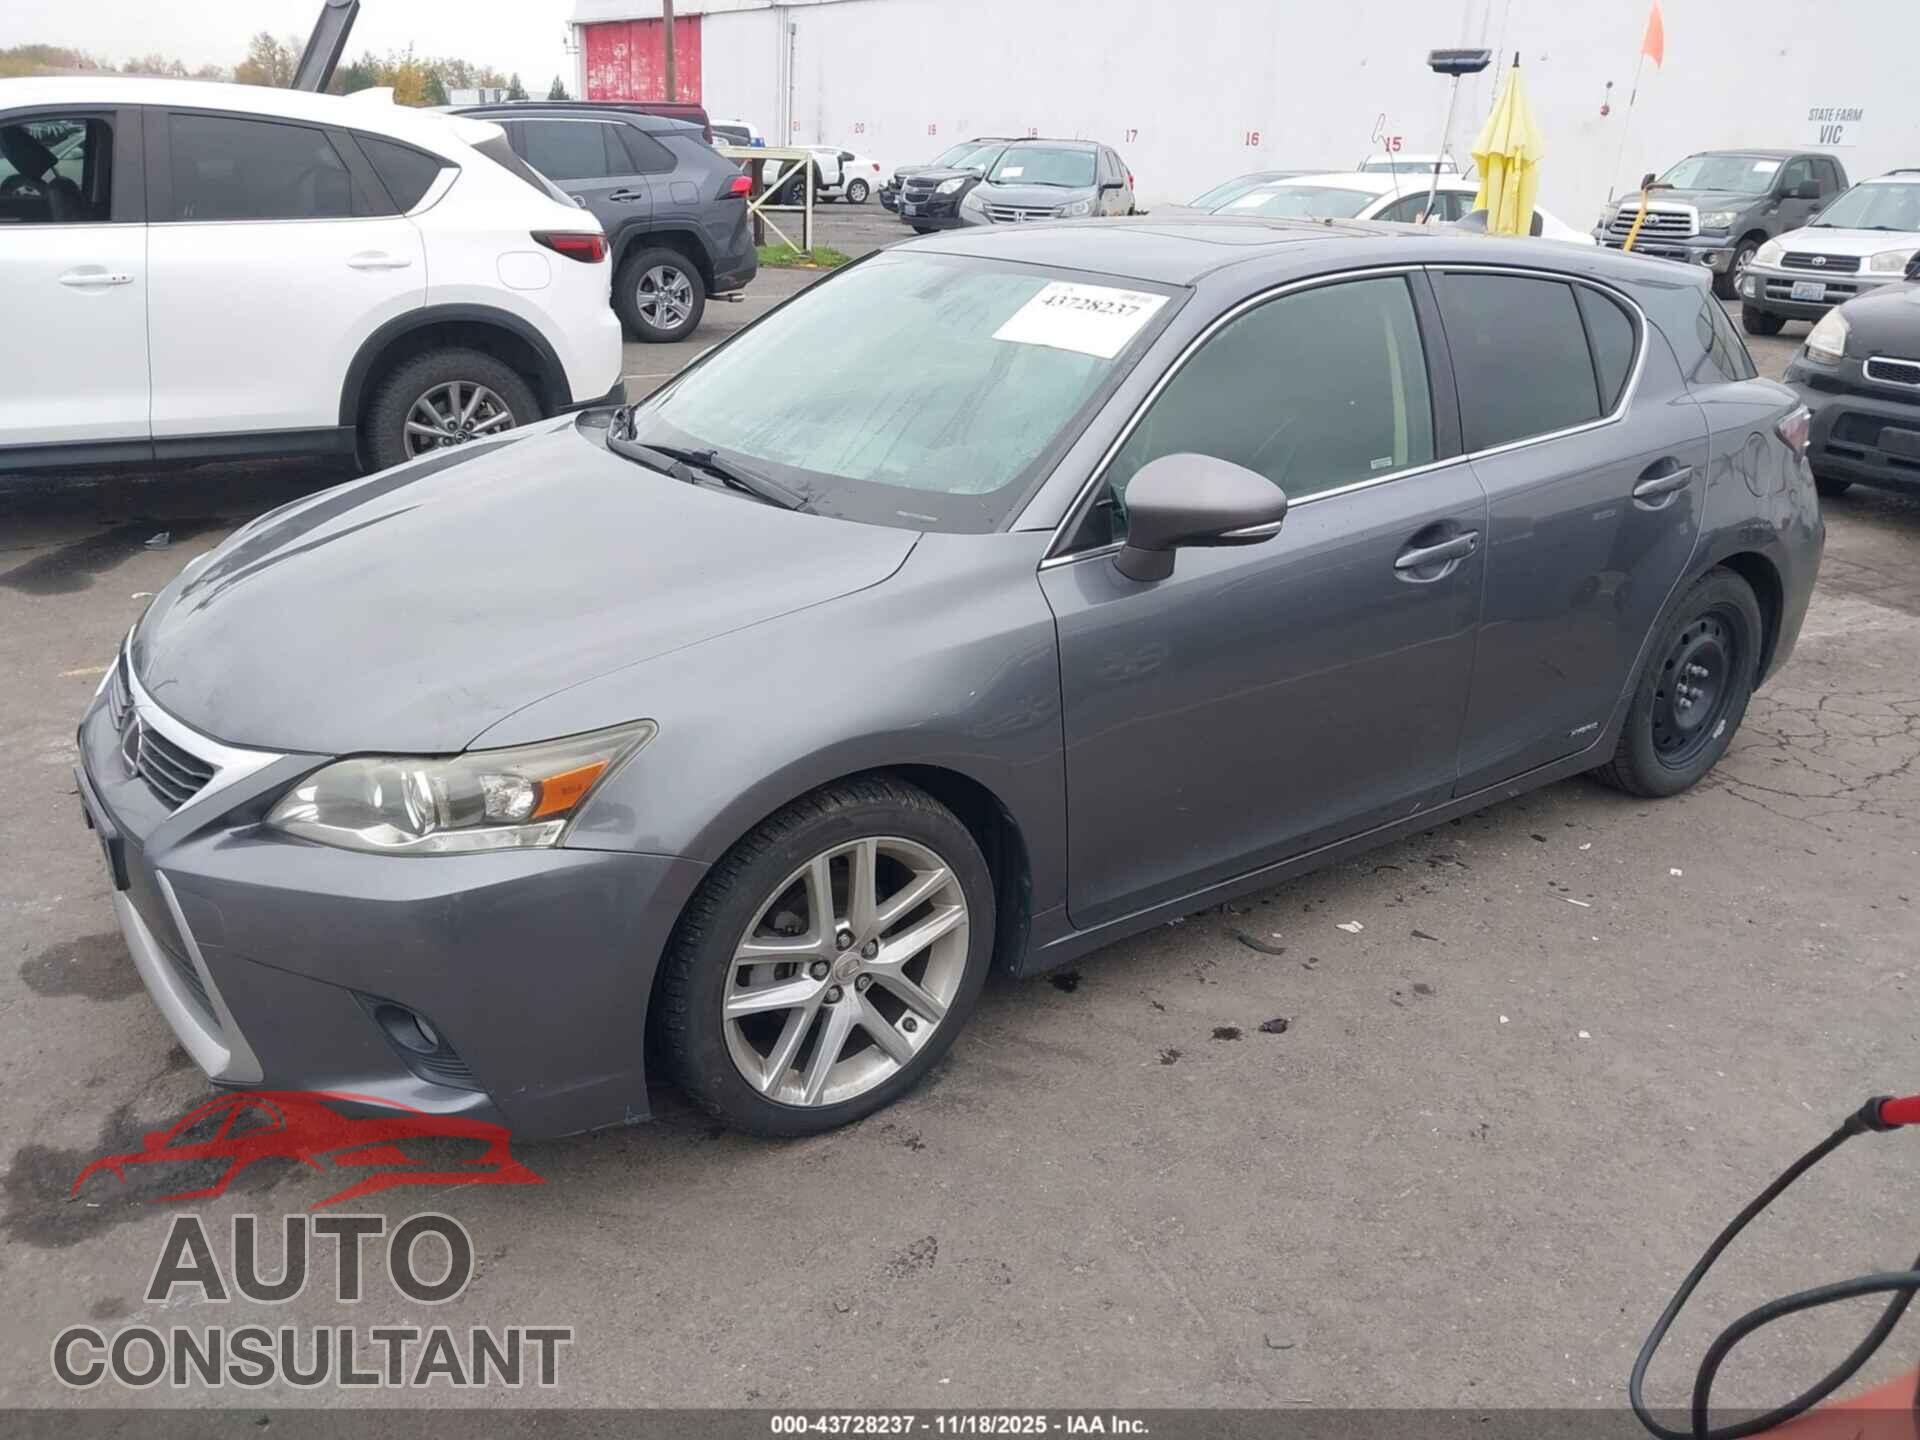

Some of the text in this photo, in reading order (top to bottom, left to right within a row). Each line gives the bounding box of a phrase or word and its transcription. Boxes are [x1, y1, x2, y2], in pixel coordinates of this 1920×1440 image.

[1808, 108, 1864, 121] STATE FARM
[855, 123, 865, 134] 20
[1126, 129, 1138, 142] 17
[1820, 125, 1843, 144] VIC
[1245, 132, 1260, 146] 16
[1385, 137, 1402, 152] 15
[1042, 294, 1141, 317] 43728237
